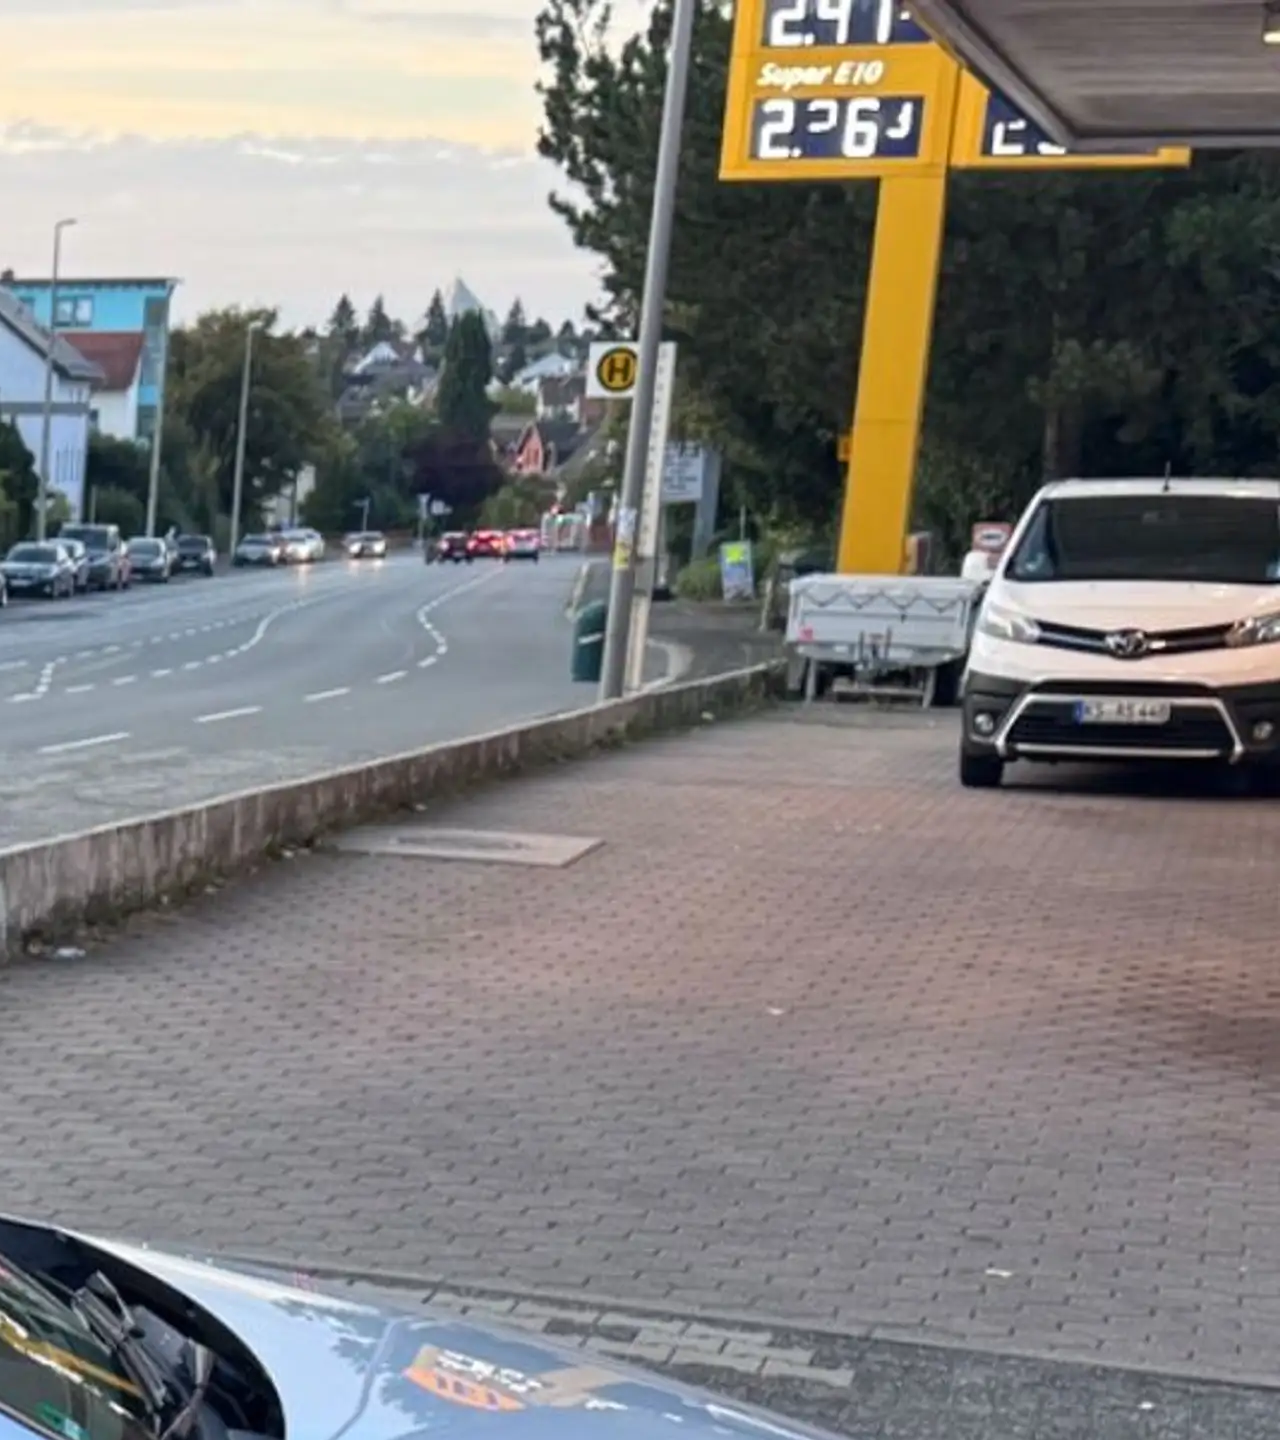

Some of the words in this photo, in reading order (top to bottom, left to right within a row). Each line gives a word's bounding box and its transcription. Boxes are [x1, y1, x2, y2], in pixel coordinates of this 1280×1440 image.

[756, 62, 832, 92] Super
[834, 60, 884, 86] E10
[607, 357, 631, 383] H
